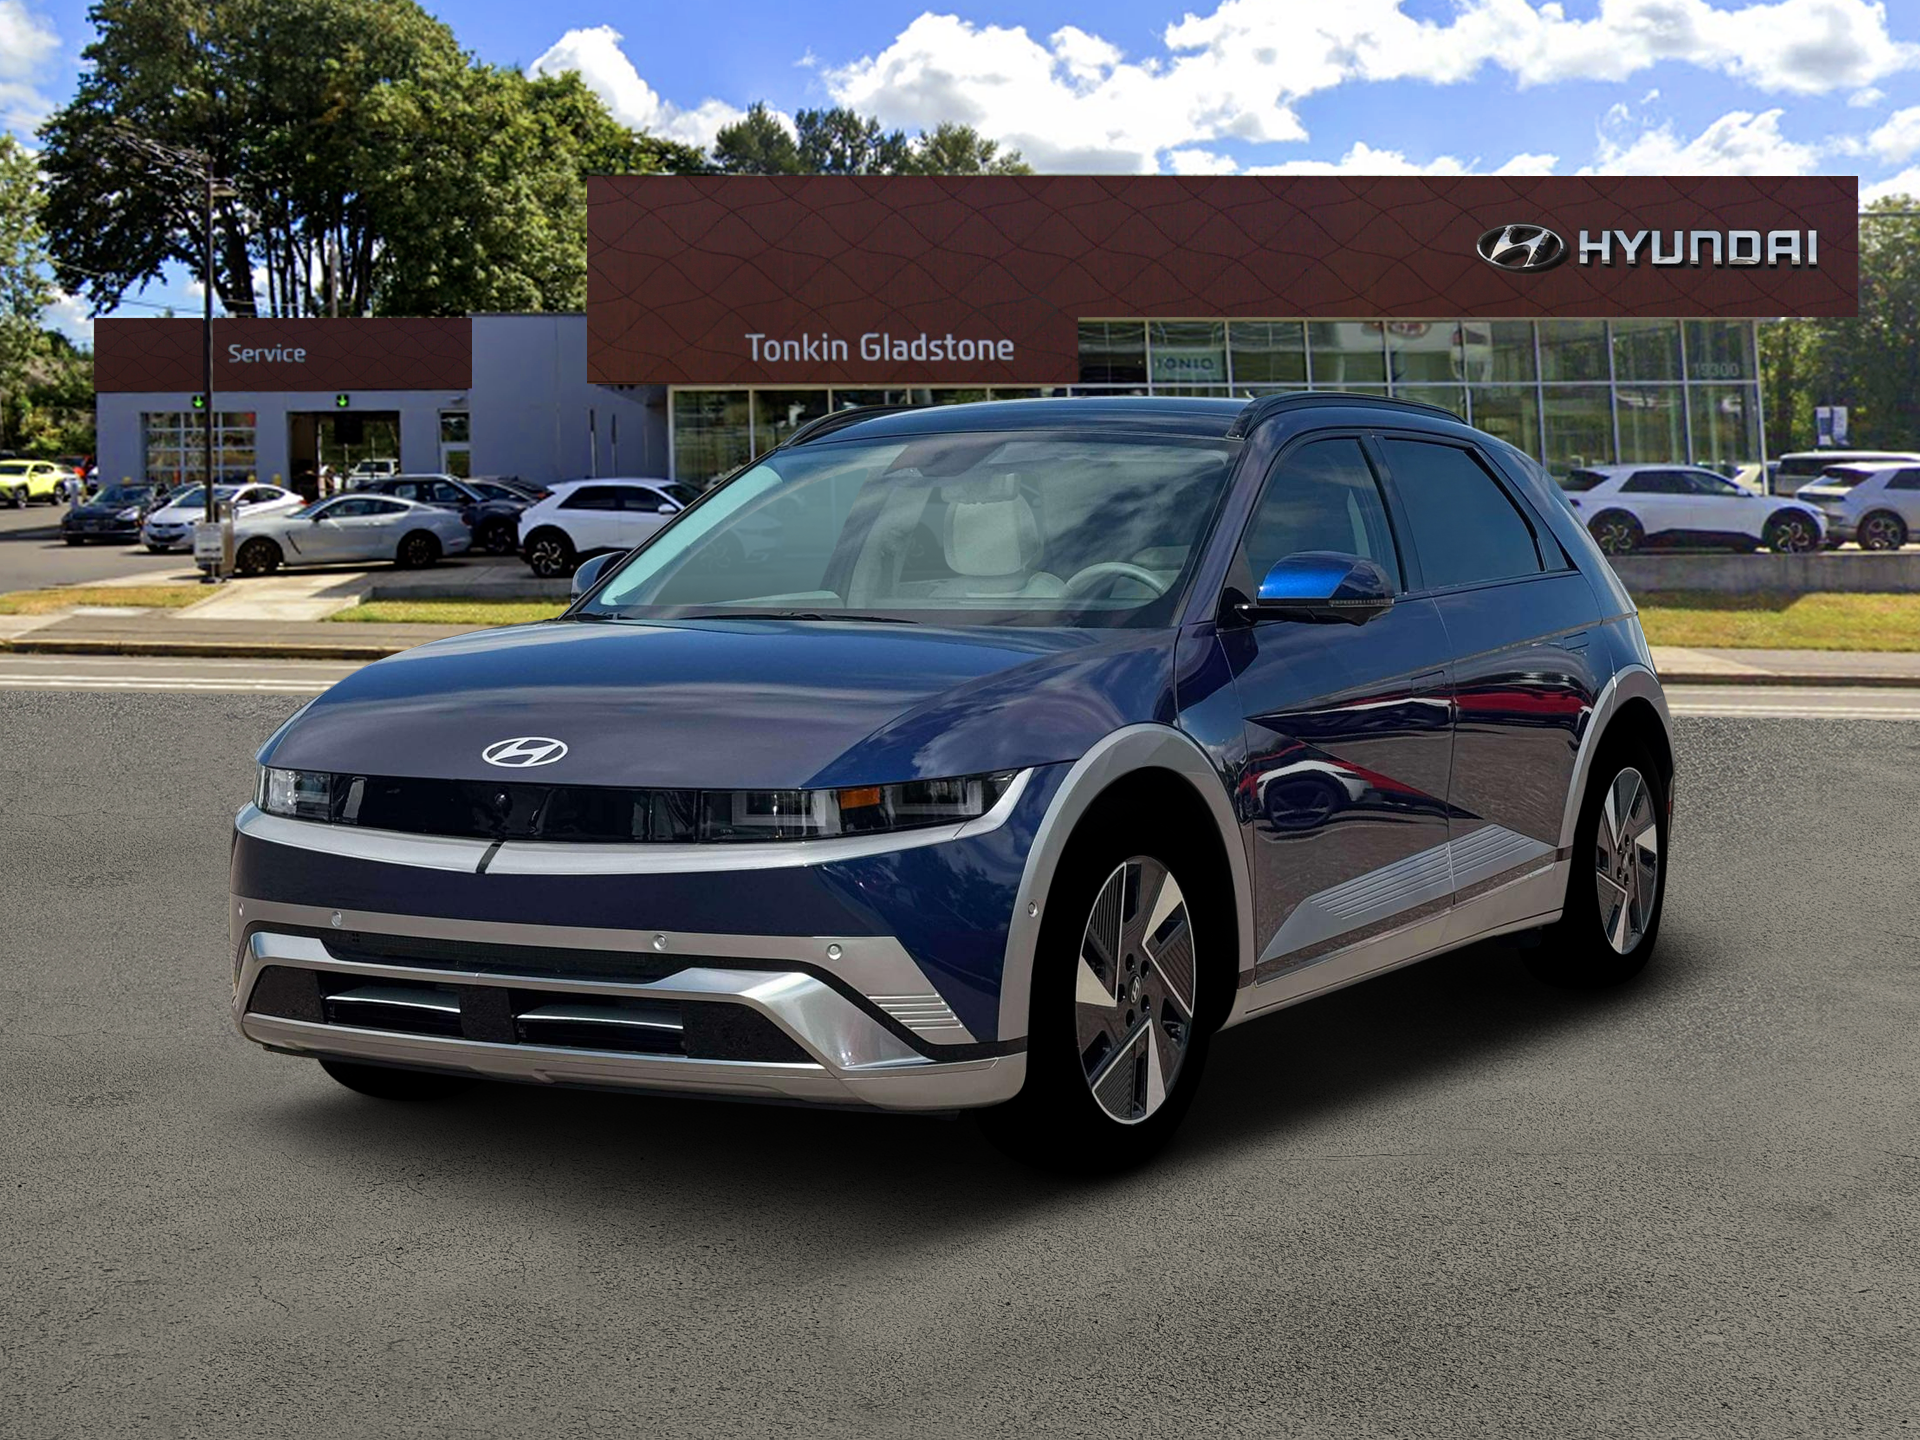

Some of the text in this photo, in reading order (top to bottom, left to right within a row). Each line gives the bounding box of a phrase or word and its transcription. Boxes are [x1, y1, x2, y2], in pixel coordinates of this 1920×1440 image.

[1578, 229, 1818, 266] HYUNDAI
[227, 343, 307, 363] Service
[744, 332, 1015, 363] Tonkin Gladstone
[1156, 357, 1215, 370] IONIQ
